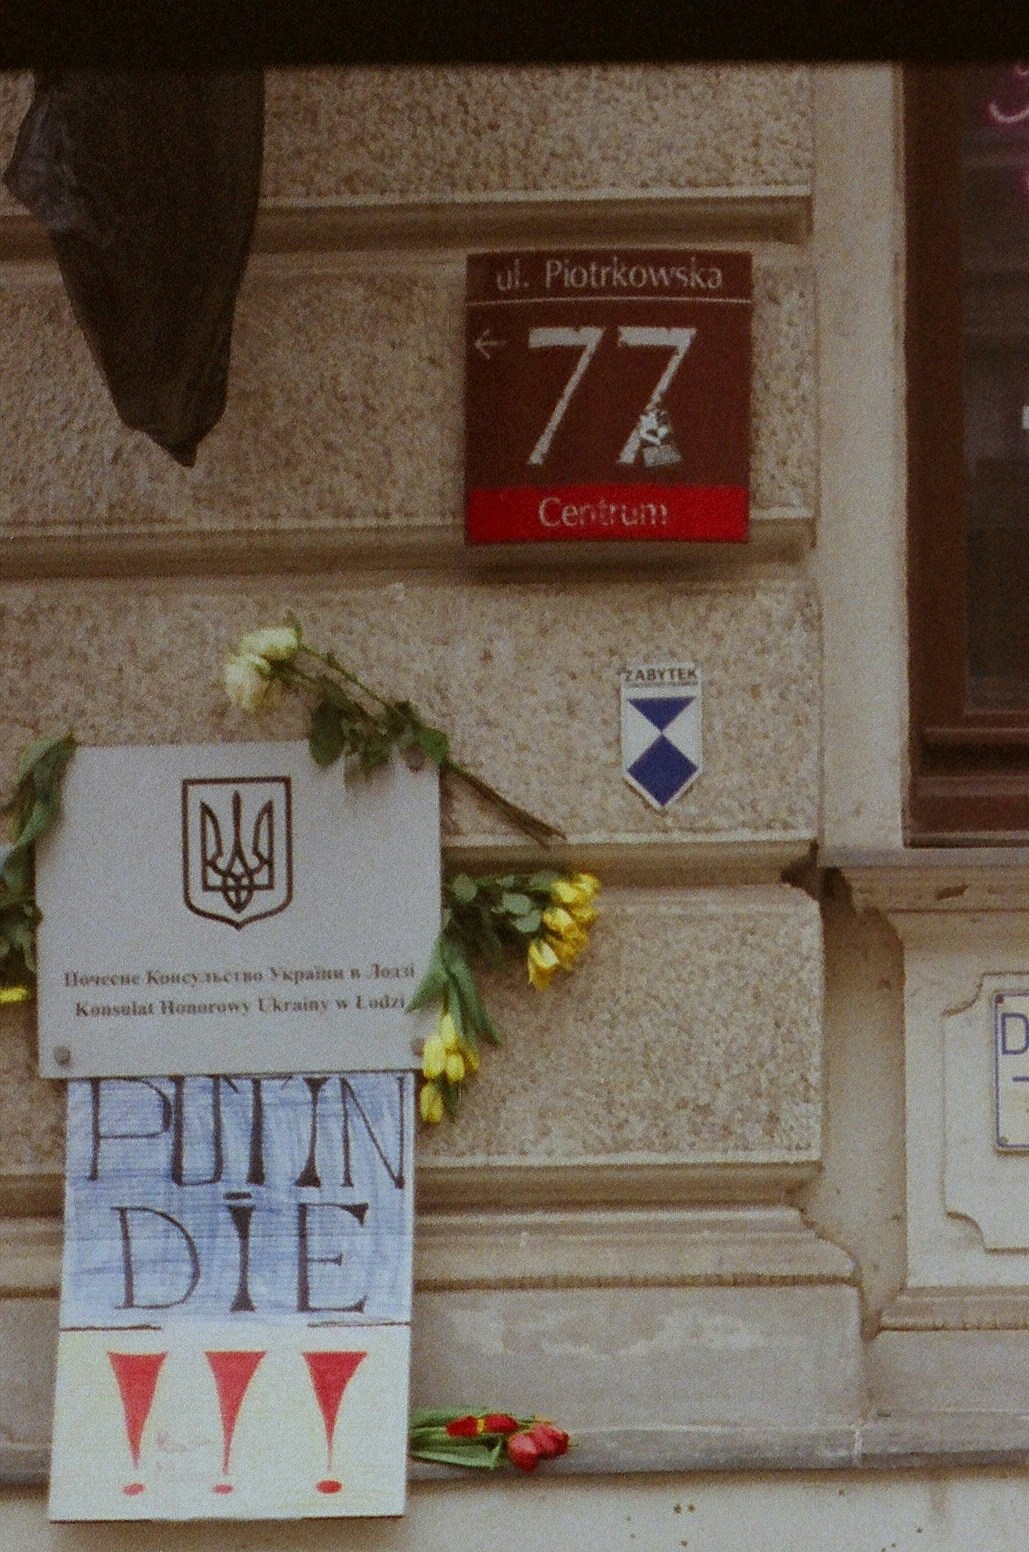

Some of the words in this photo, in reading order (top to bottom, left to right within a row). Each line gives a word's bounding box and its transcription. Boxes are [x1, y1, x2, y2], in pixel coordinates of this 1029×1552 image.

[496, 258, 530, 291] ul.
[545, 256, 723, 290] Piotrkowska
[527, 326, 697, 466] 77
[537, 496, 668, 528] Centrum
[624, 668, 699, 683] ZABYTEK
[75, 1001, 154, 1017] Konsulat
[160, 999, 250, 1017] Honorowy
[258, 996, 328, 1014] Ukrainy
[335, 998, 348, 1012] w
[86, 1075, 408, 1190] PUTIN
[110, 1194, 370, 1314] DIE
